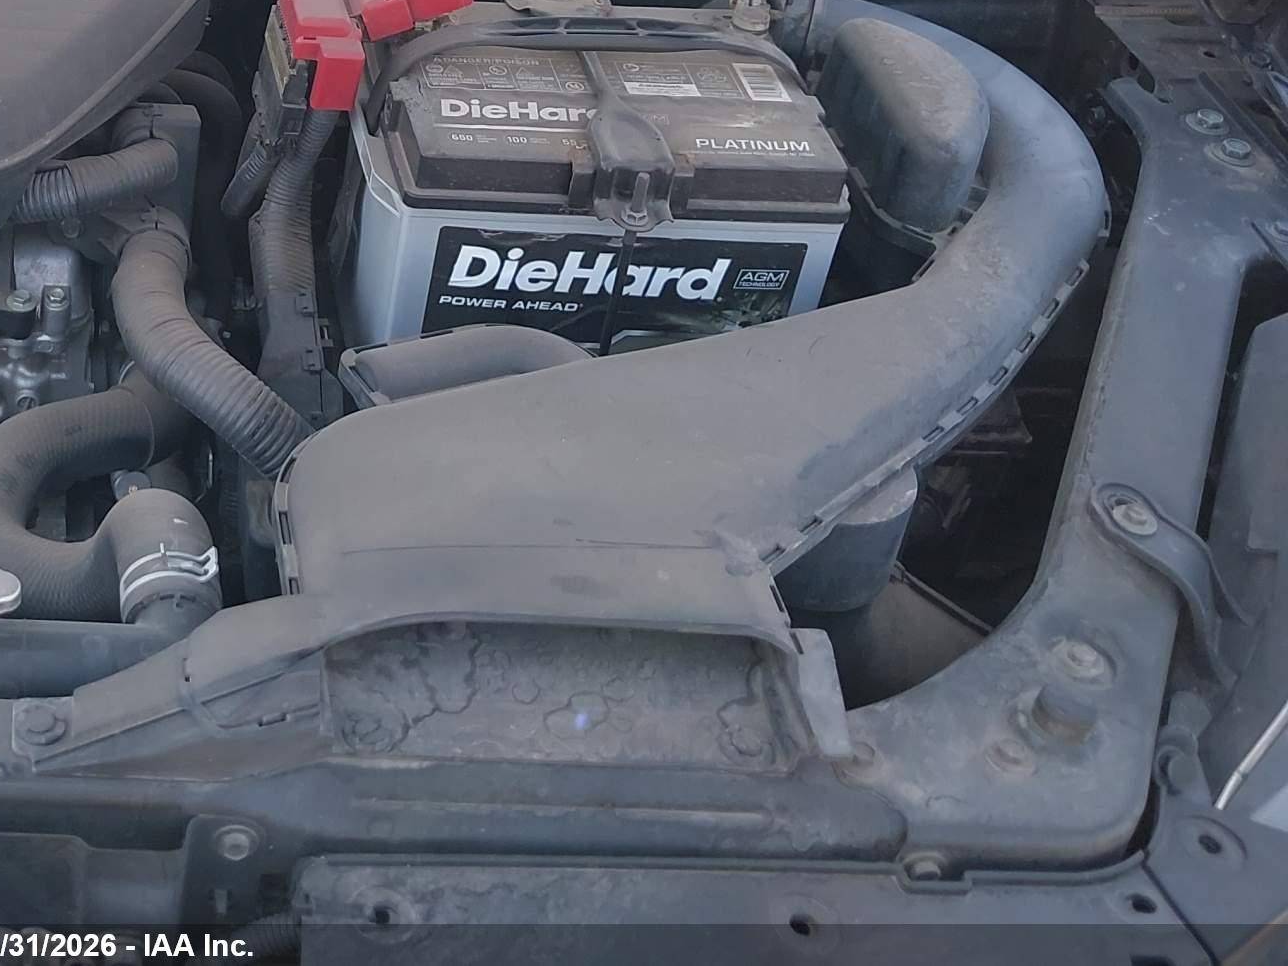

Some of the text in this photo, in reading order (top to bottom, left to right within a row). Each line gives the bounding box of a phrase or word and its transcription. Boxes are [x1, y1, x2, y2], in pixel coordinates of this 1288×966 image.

[507, 136, 528, 144] 100
[695, 138, 811, 152] PLATINUM
[448, 245, 732, 301] DieHard
[740, 271, 785, 282] AGM
[438, 295, 580, 312] POWER AHEAD
